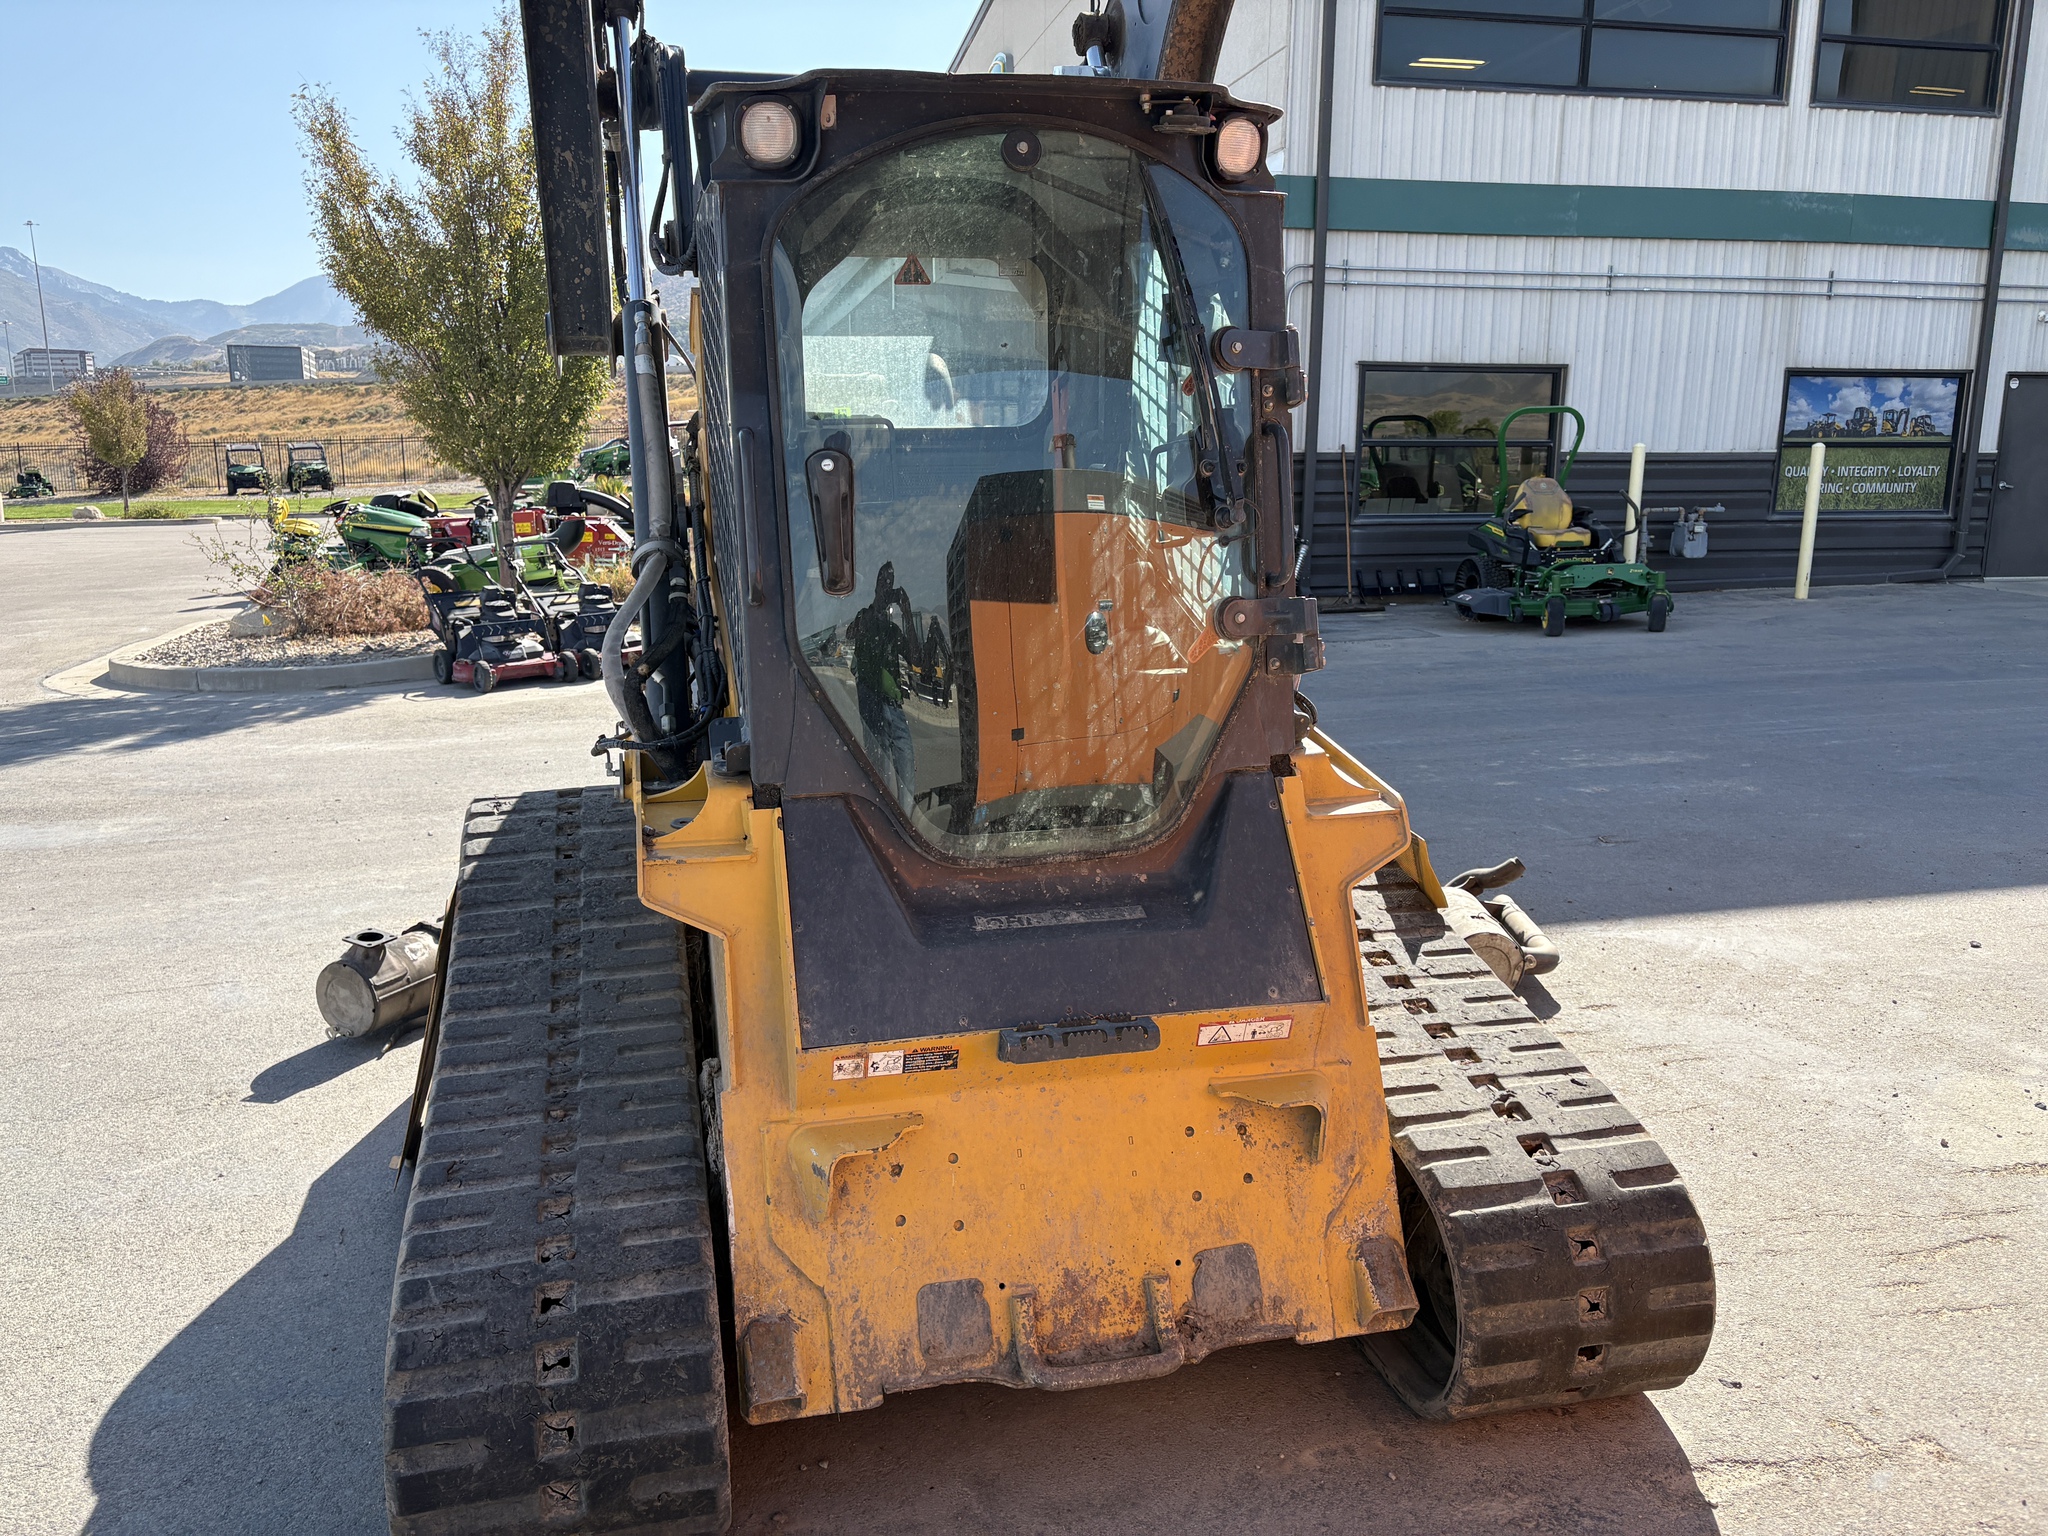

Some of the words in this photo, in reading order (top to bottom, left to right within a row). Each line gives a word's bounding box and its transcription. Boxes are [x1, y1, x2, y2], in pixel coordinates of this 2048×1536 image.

[1785, 466, 1829, 477] QUALY
[1837, 466, 1890, 477] INTEGRITY
[1898, 466, 1940, 477] LOYALTY
[1805, 482, 1843, 494] RING
[1852, 482, 1917, 494] COMMUNITY
